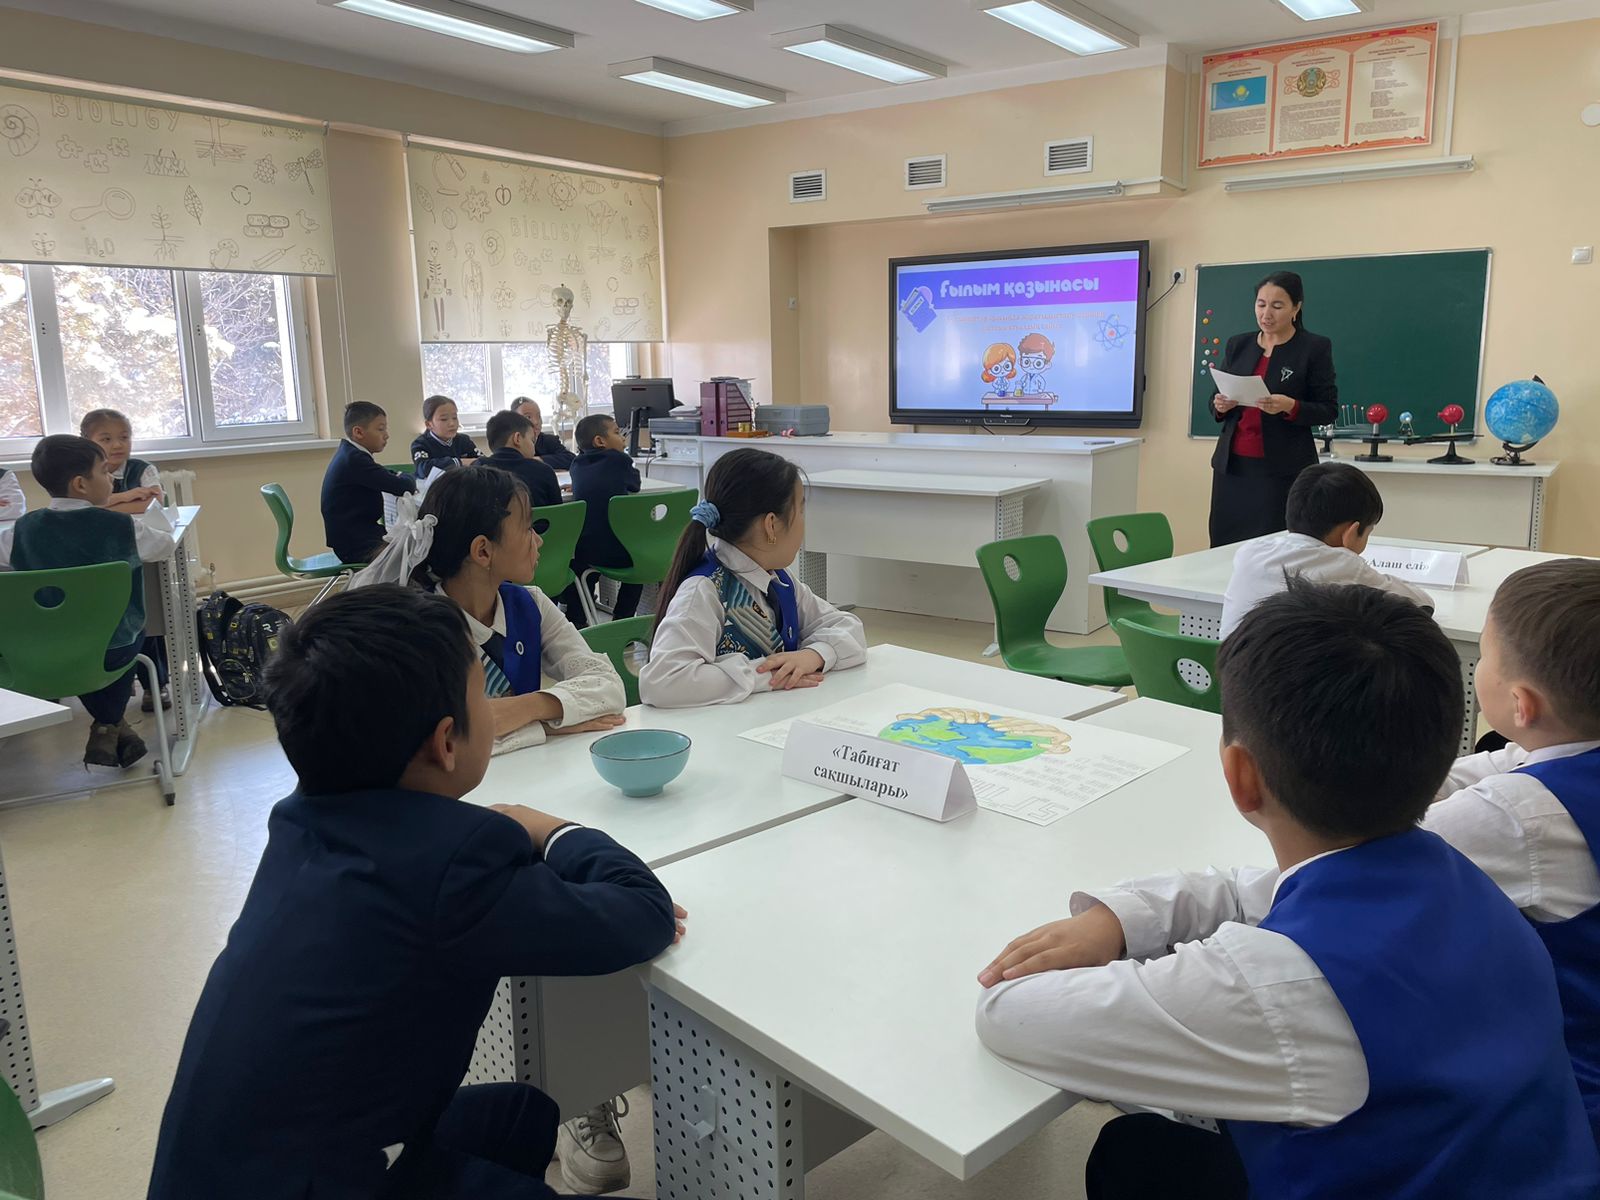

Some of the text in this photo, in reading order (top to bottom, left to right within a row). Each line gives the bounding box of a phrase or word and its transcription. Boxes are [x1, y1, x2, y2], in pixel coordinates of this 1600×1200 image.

[1004, 277, 1099, 299] қазынасы
[832, 744, 900, 773] «Табиғат
[814, 764, 909, 800] сақшылары»
